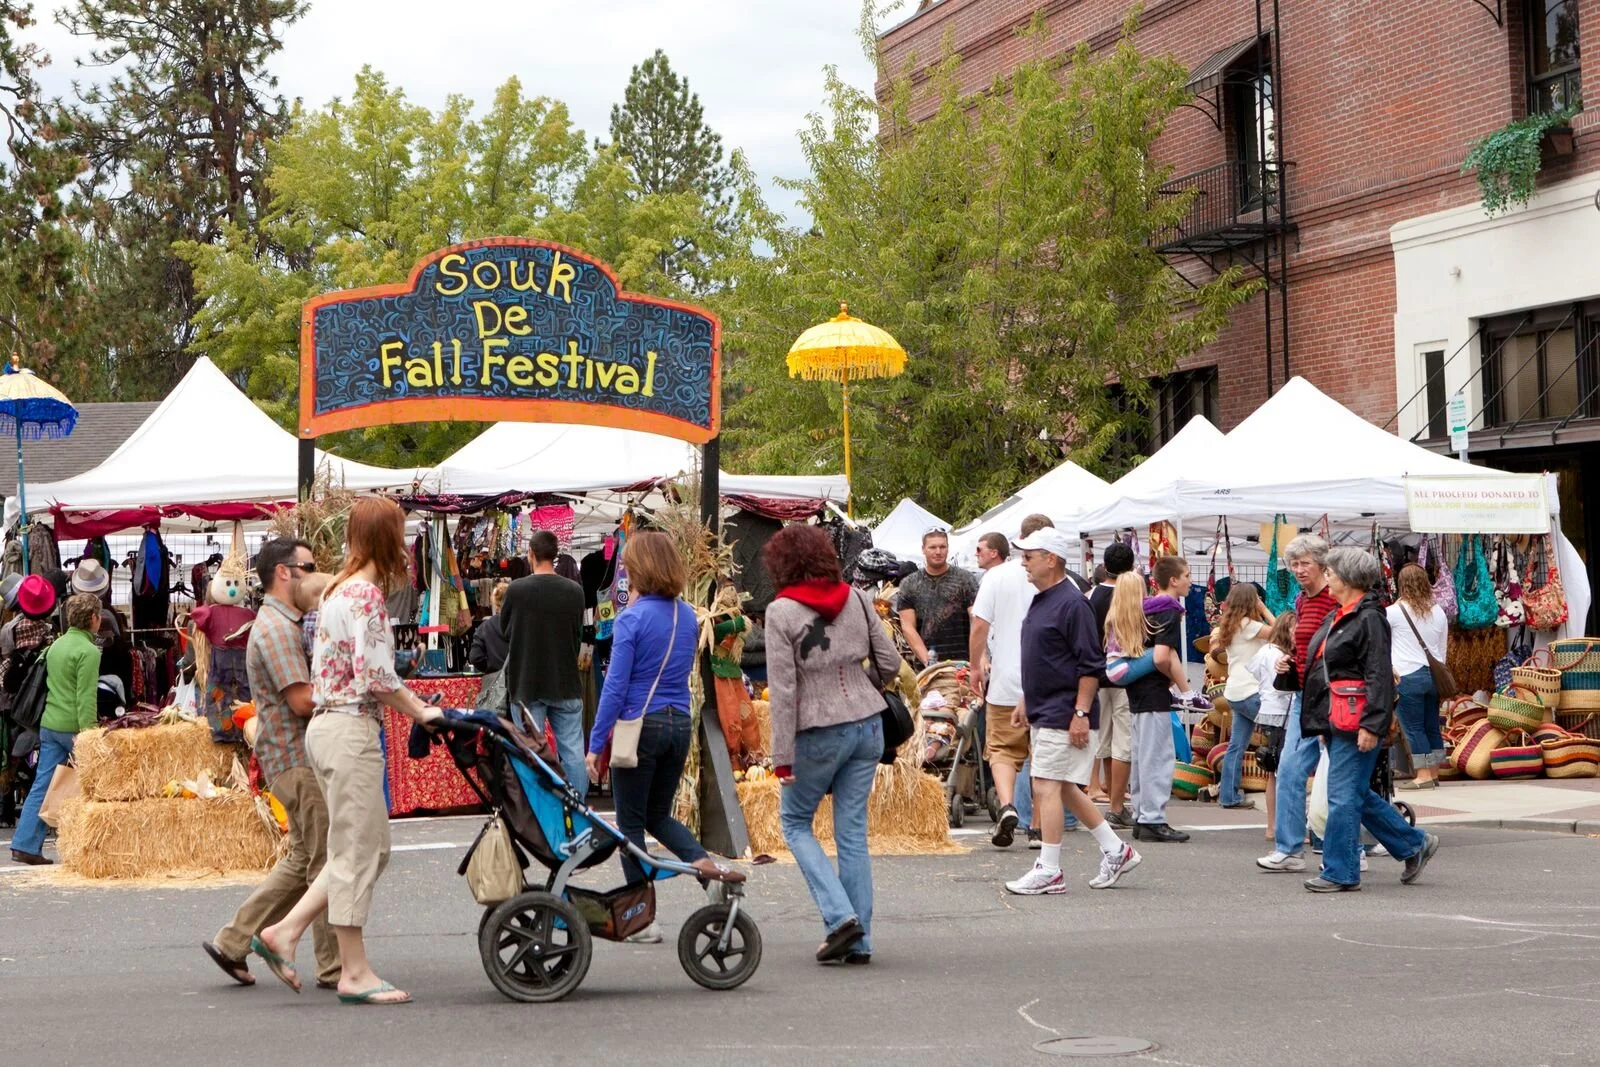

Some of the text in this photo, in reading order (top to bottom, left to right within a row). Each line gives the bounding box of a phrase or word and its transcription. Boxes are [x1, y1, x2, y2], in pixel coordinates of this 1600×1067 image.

[436, 251, 576, 303] Souk
[474, 300, 532, 339] De
[381, 338, 657, 398] Fall Festival
